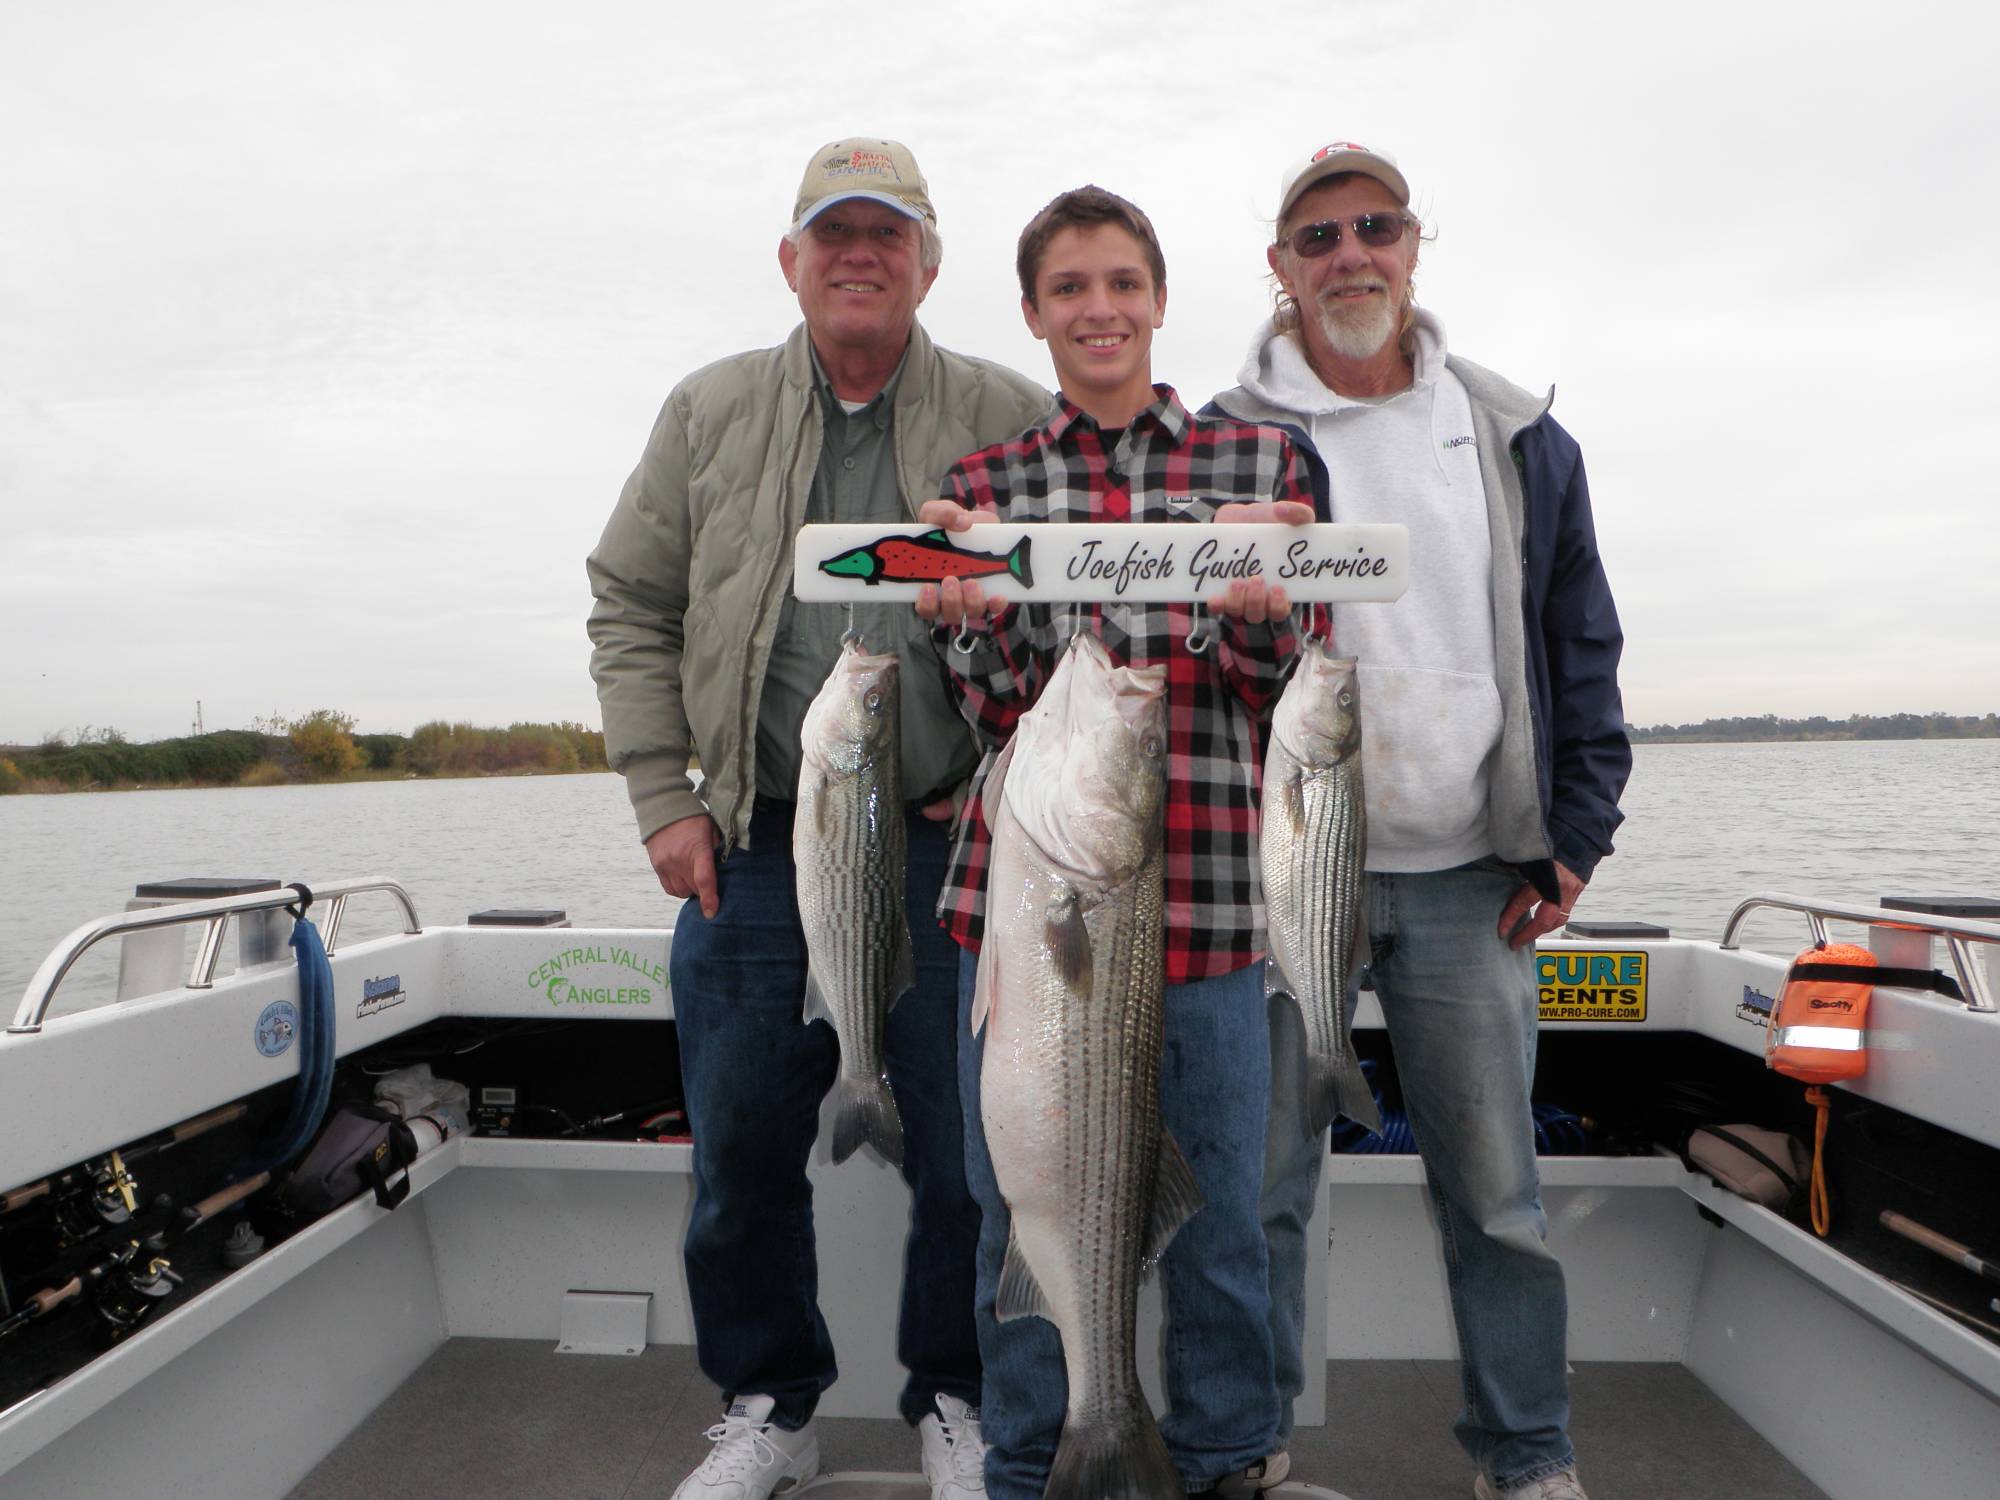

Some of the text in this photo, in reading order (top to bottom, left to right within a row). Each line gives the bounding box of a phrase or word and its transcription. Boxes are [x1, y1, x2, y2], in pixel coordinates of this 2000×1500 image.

[1066, 539, 1388, 594] Joefish Guide Service
[528, 946, 607, 989] CENTRAL
[566, 985, 651, 1004] ANGLERS
[1538, 988, 1638, 1005] CENTS
[1538, 1007, 1640, 1018] WW.PRO-CURE.COM
[1810, 999, 1854, 1012] Scotty
